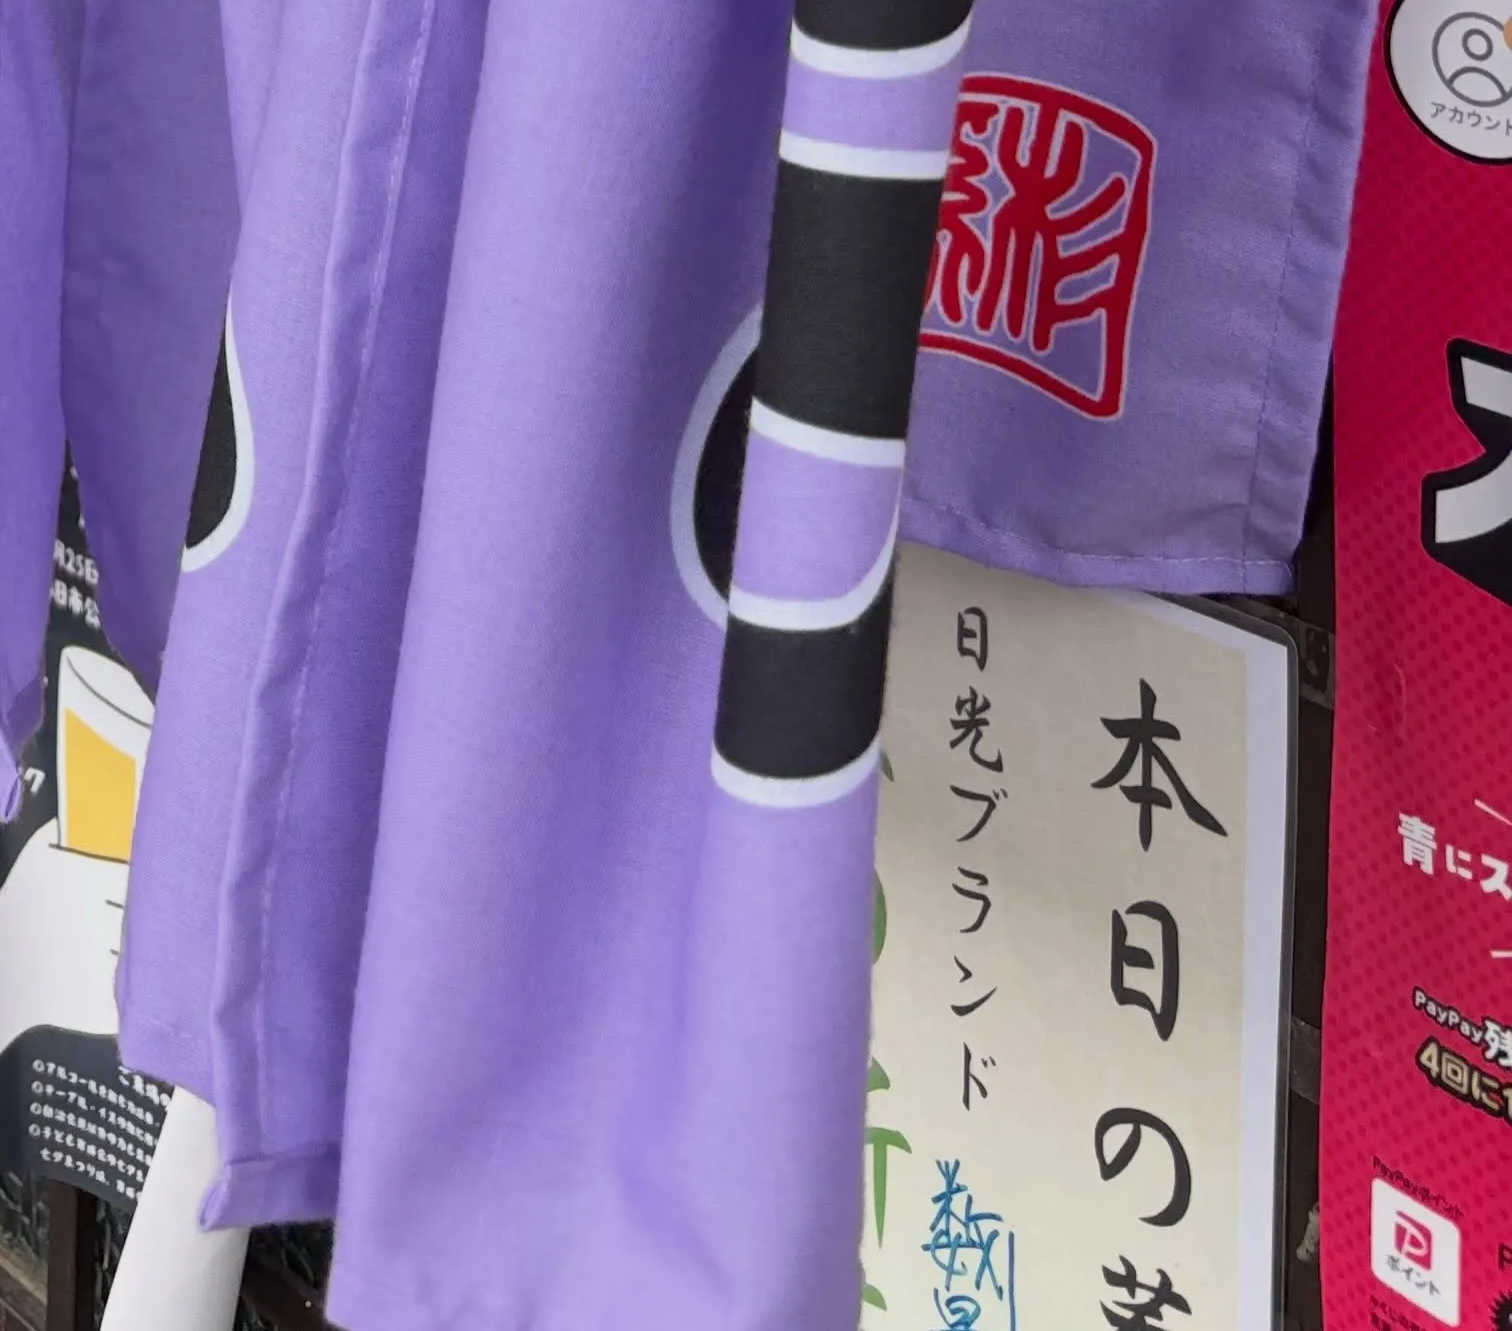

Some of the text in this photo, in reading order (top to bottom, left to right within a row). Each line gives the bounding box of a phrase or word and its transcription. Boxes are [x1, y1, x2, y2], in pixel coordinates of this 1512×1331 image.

[1430, 101, 1512, 136] アカウント
[949, 606, 1007, 1111] 日光ブランド
